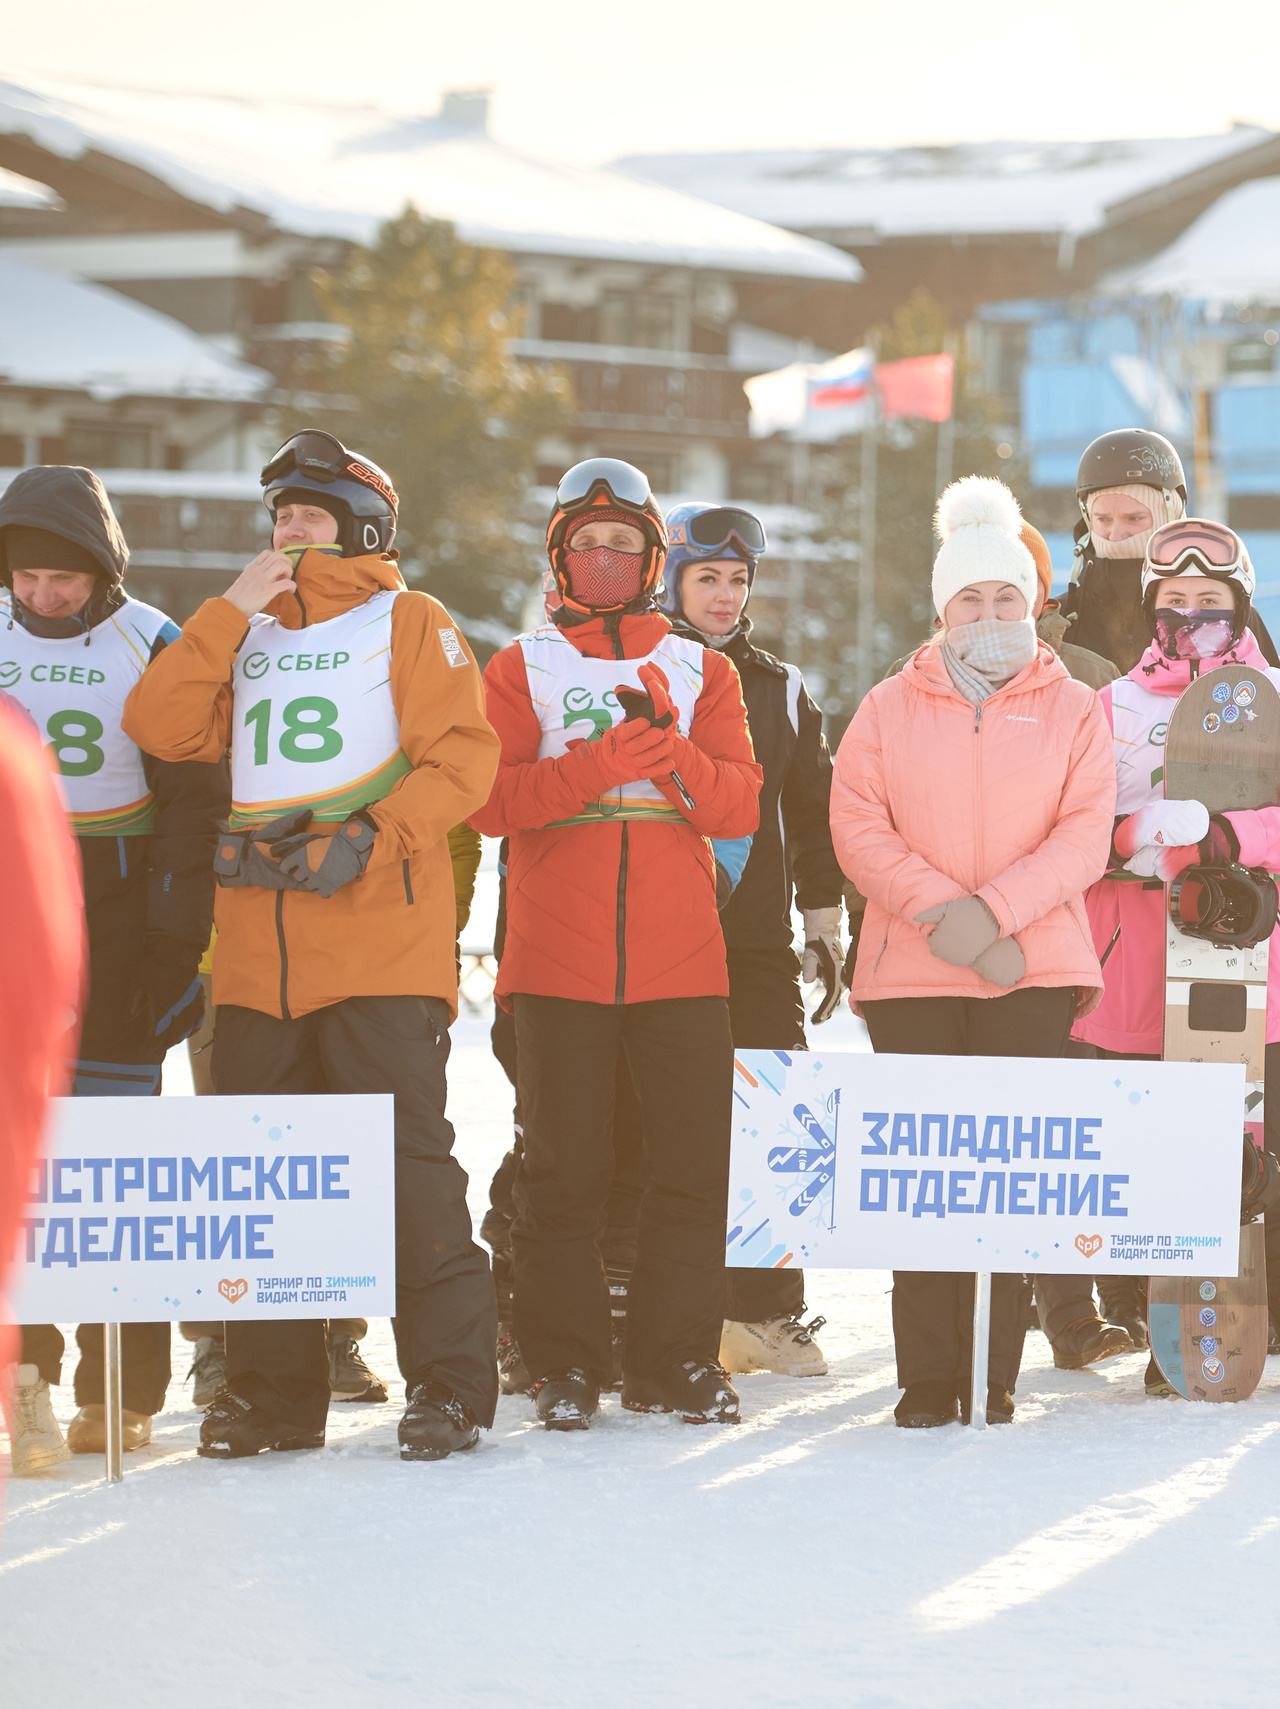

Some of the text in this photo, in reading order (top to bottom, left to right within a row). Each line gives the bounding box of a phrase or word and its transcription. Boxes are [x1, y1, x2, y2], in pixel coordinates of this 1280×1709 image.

[30, 664, 105, 686] СБЕР
[277, 651, 350, 671] СБЕР
[44, 709, 105, 777] 8
[244, 696, 344, 767] 18
[861, 1112, 1102, 1163] ЗАПАДНОЕ
[28, 1155, 350, 1203] ОСТРОМСКОЕ
[860, 1168, 1129, 1218] ОТДЕЛЕНИЕ
[18, 1214, 274, 1268] ТДЕЛЕНИЕ
[1110, 1234, 1221, 1247] ТУРНИР ПО ЗИМНИМ
[1110, 1248, 1193, 1260] ВИДАМ СПОРТА
[256, 1276, 376, 1289] ТУРНИР ПО ЗИМНИМ
[256, 1290, 347, 1304] ВИДАМ СПОРТА
